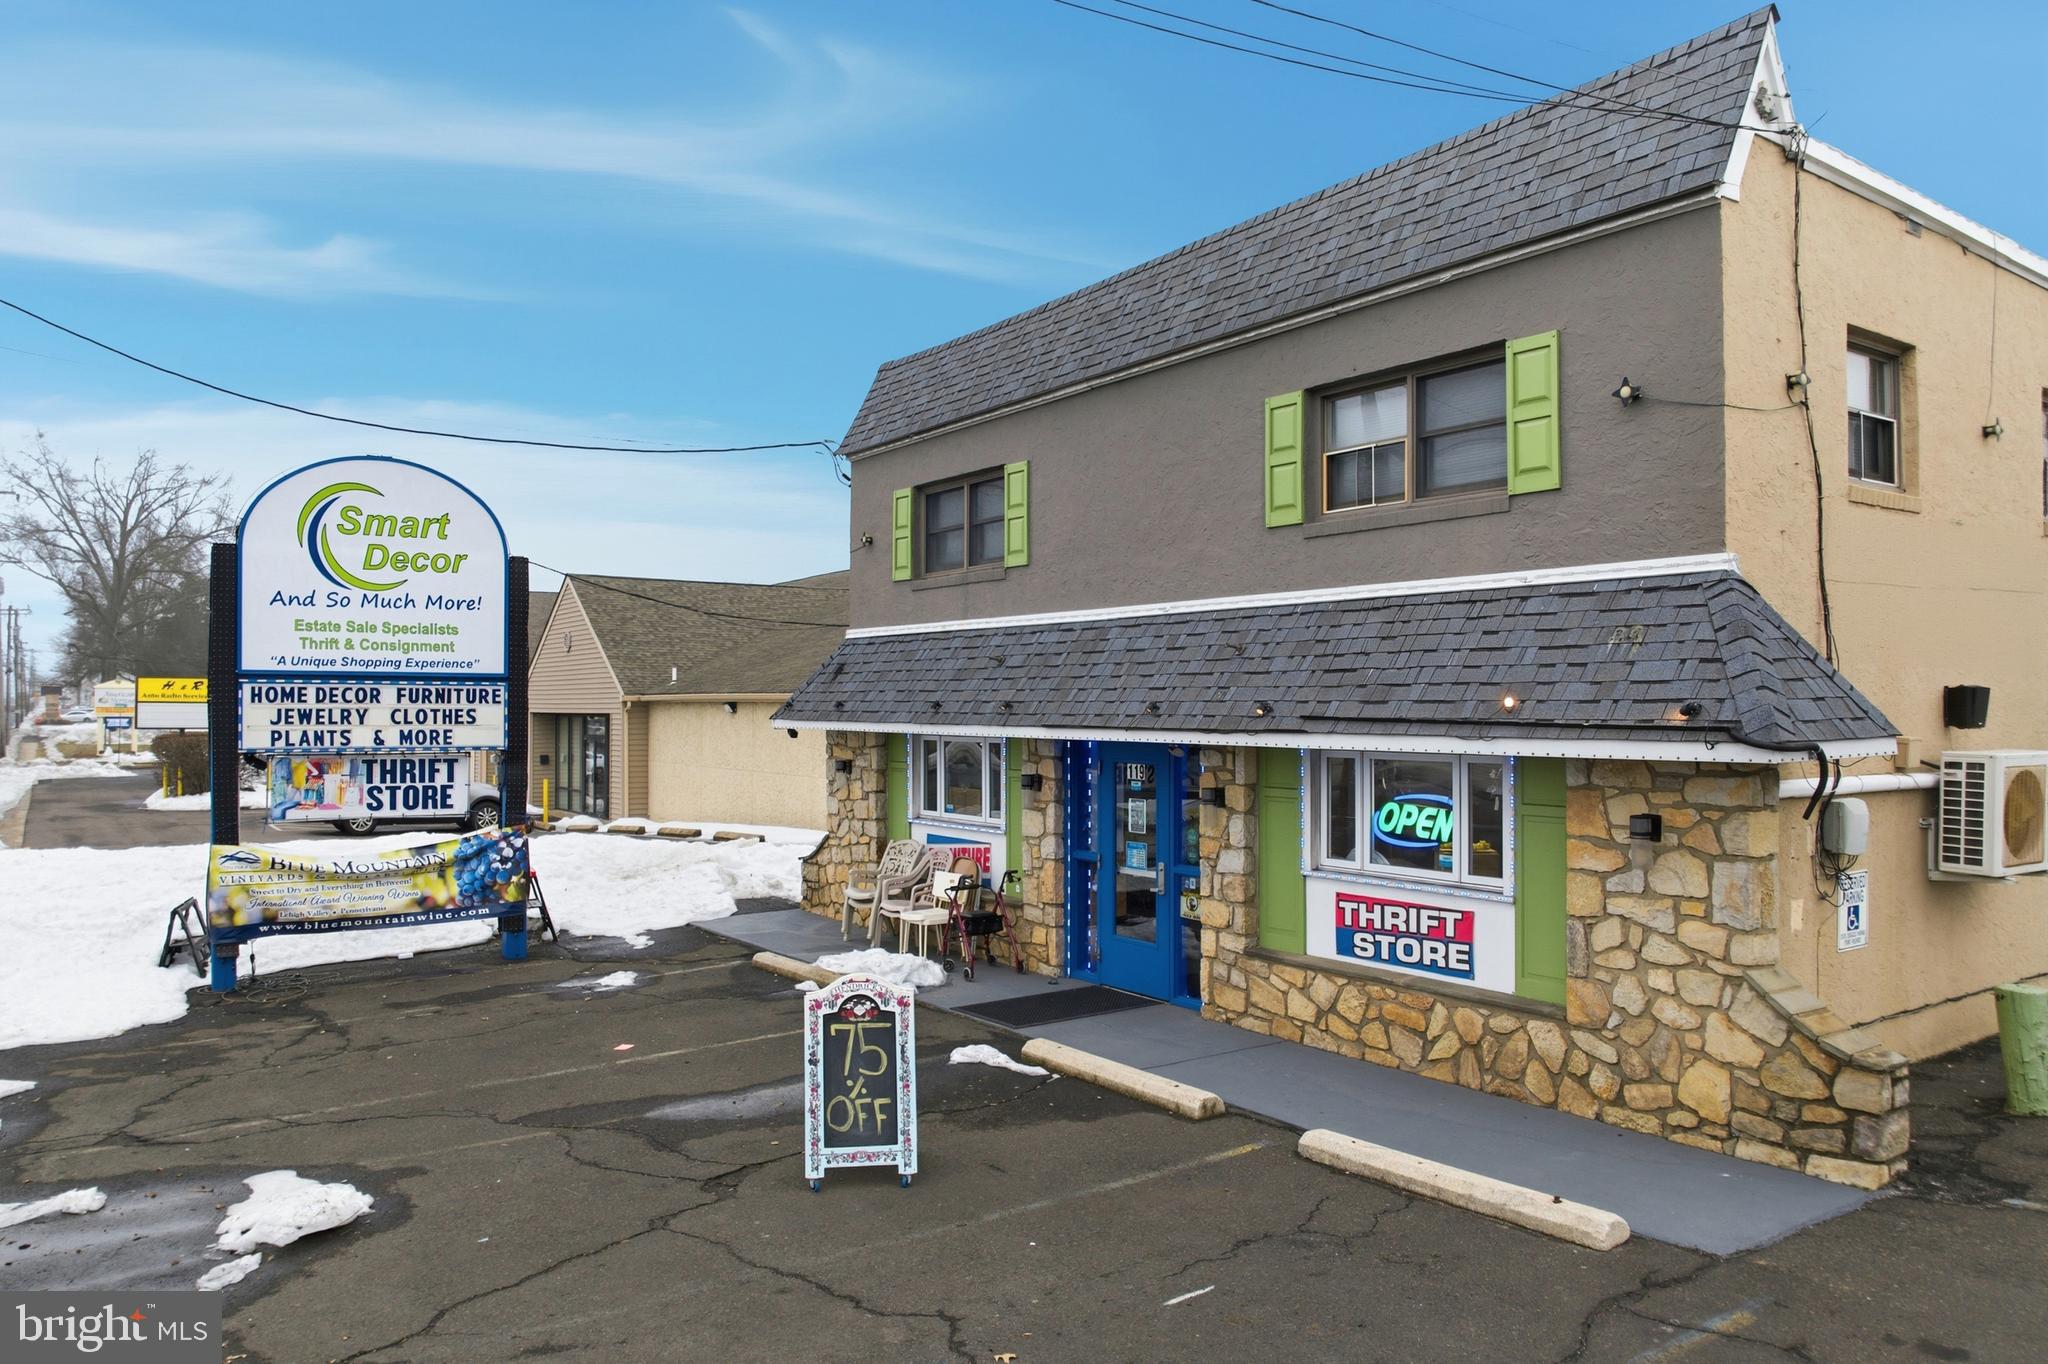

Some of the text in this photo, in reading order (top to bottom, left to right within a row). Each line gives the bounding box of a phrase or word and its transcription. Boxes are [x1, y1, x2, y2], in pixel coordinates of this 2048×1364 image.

[337, 505, 450, 540] Smart
[362, 543, 468, 573] Decor
[269, 589, 482, 611] And So Much More!
[294, 619, 459, 637] Estate Sale Specialists
[299, 636, 455, 654] Thrift & Consignment
[291, 656, 337, 669] Unique
[341, 656, 401, 670] Shopping
[250, 686, 502, 705] HOME DECOR FURNITURE
[269, 708, 477, 726] JEWELRY CLOTHES
[270, 729, 453, 747] PLANTS & MORE
[362, 758, 459, 784] THRIFT
[366, 784, 454, 811] STORE
[1377, 801, 1453, 843] OPEN
[268, 857, 325, 874] BLUE
[332, 852, 447, 874] MOUNTAIN
[219, 873, 304, 884] VINEYARDS
[321, 881, 364, 891] Everything
[366, 880, 374, 888] in
[246, 897, 308, 910] International
[259, 907, 490, 932] www.bluemountainwine.com
[1338, 900, 1462, 938] THRIFT
[1352, 932, 1471, 971] STORE
[830, 1022, 892, 1077] 75
[846, 1076, 868, 1099] %
[827, 1095, 892, 1136] OFF
